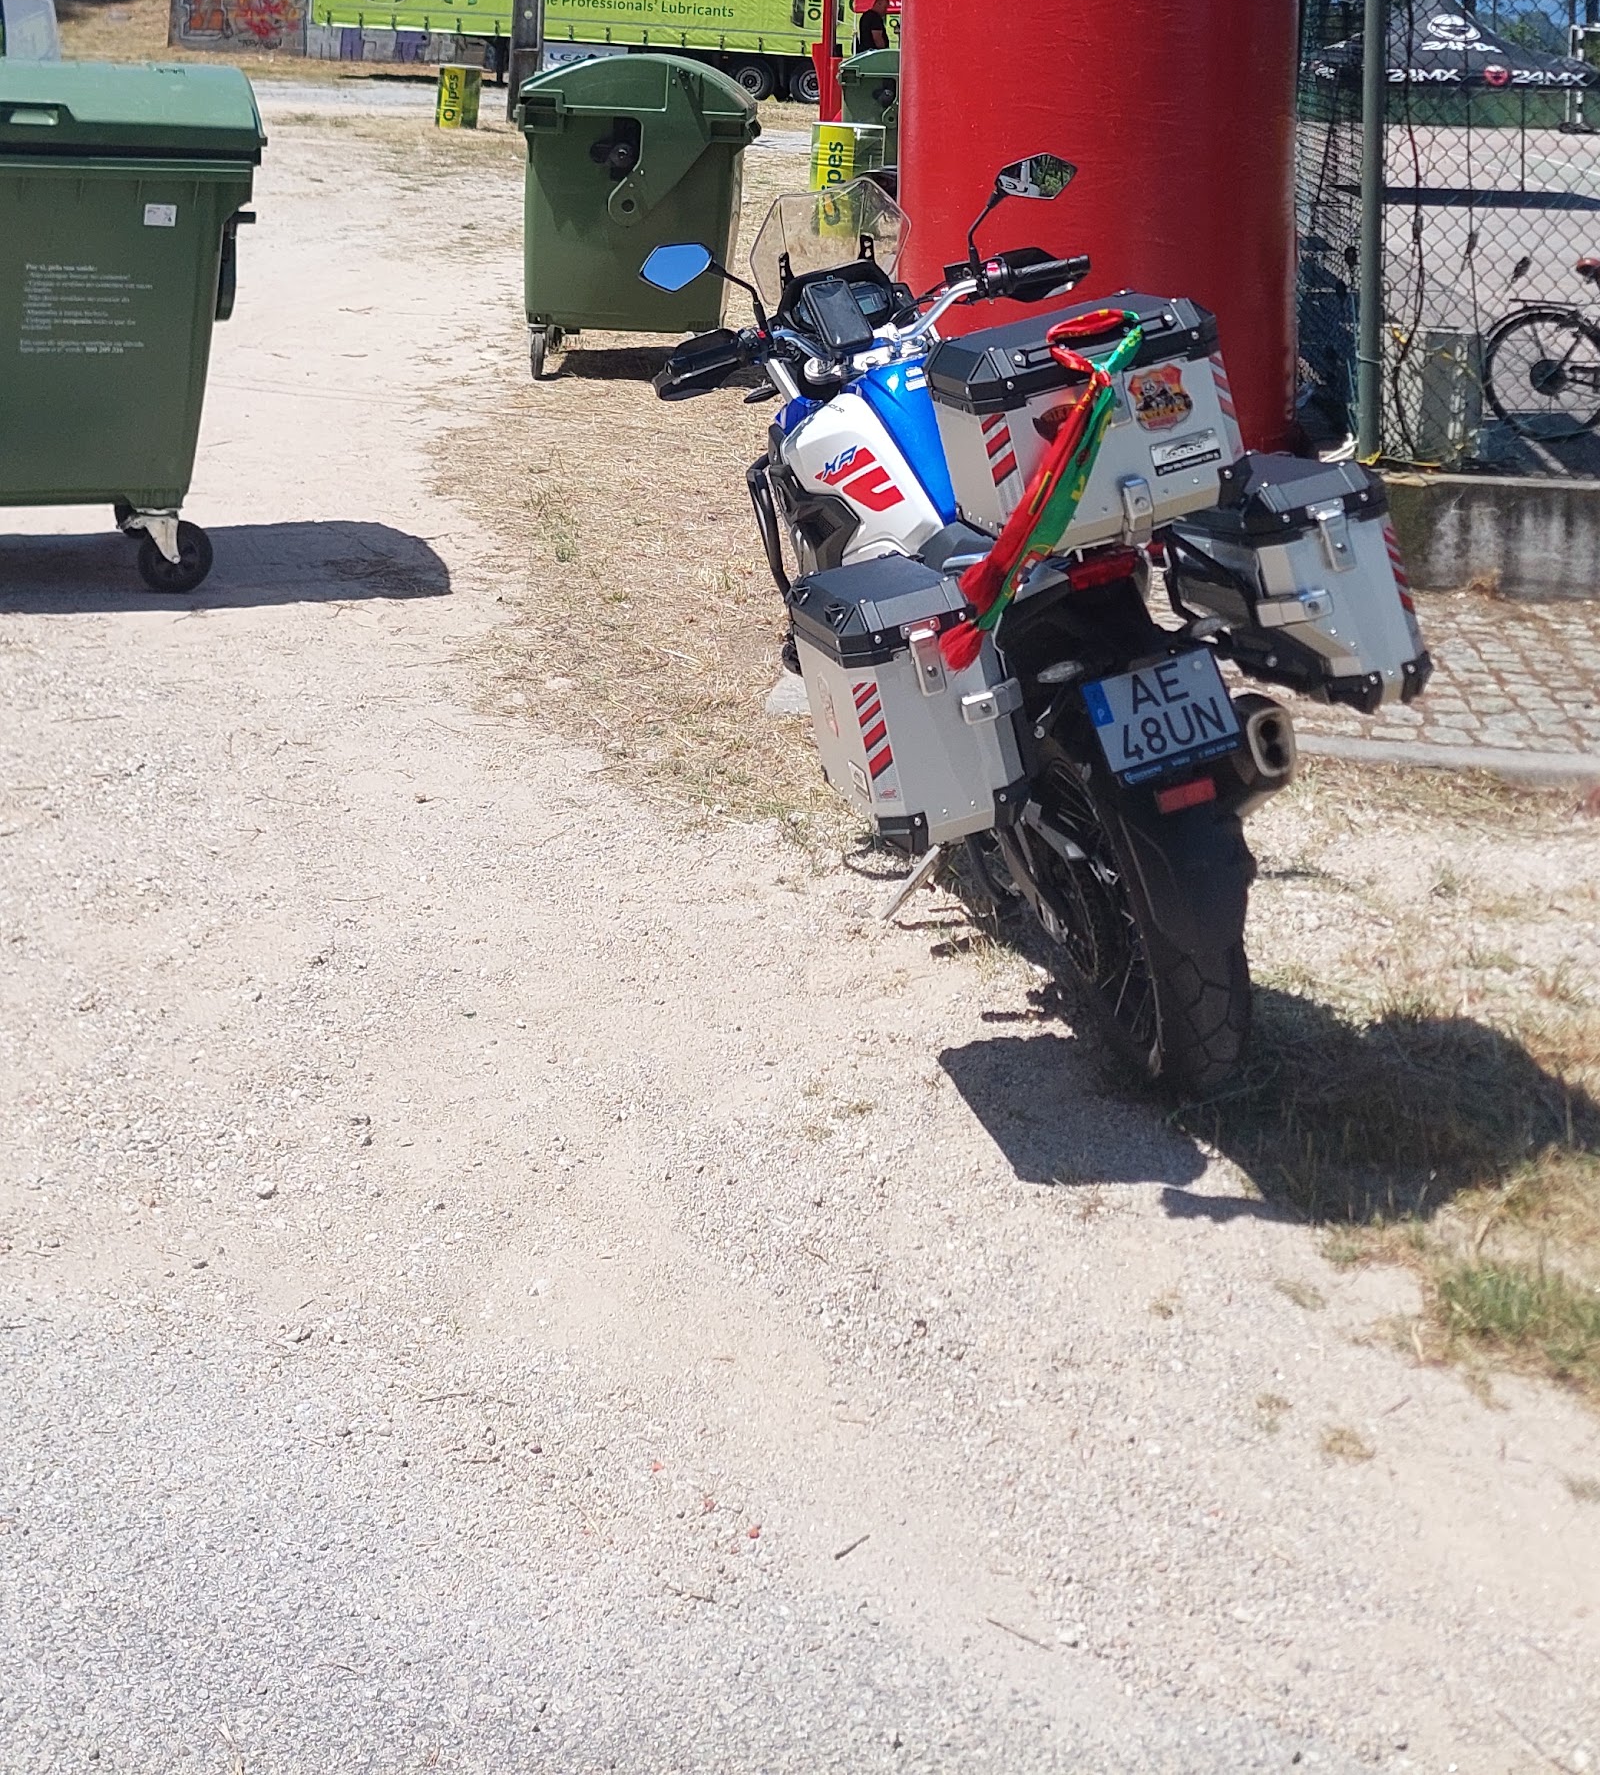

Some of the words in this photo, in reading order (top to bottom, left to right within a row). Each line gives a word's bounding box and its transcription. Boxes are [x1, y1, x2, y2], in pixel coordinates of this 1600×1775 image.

[661, 1, 735, 18] Lubricants
[442, 74, 460, 122] Olipes
[1511, 70, 1588, 87] 24MX
[1131, 662, 1190, 715] AE
[1123, 697, 1228, 761] 48UN
